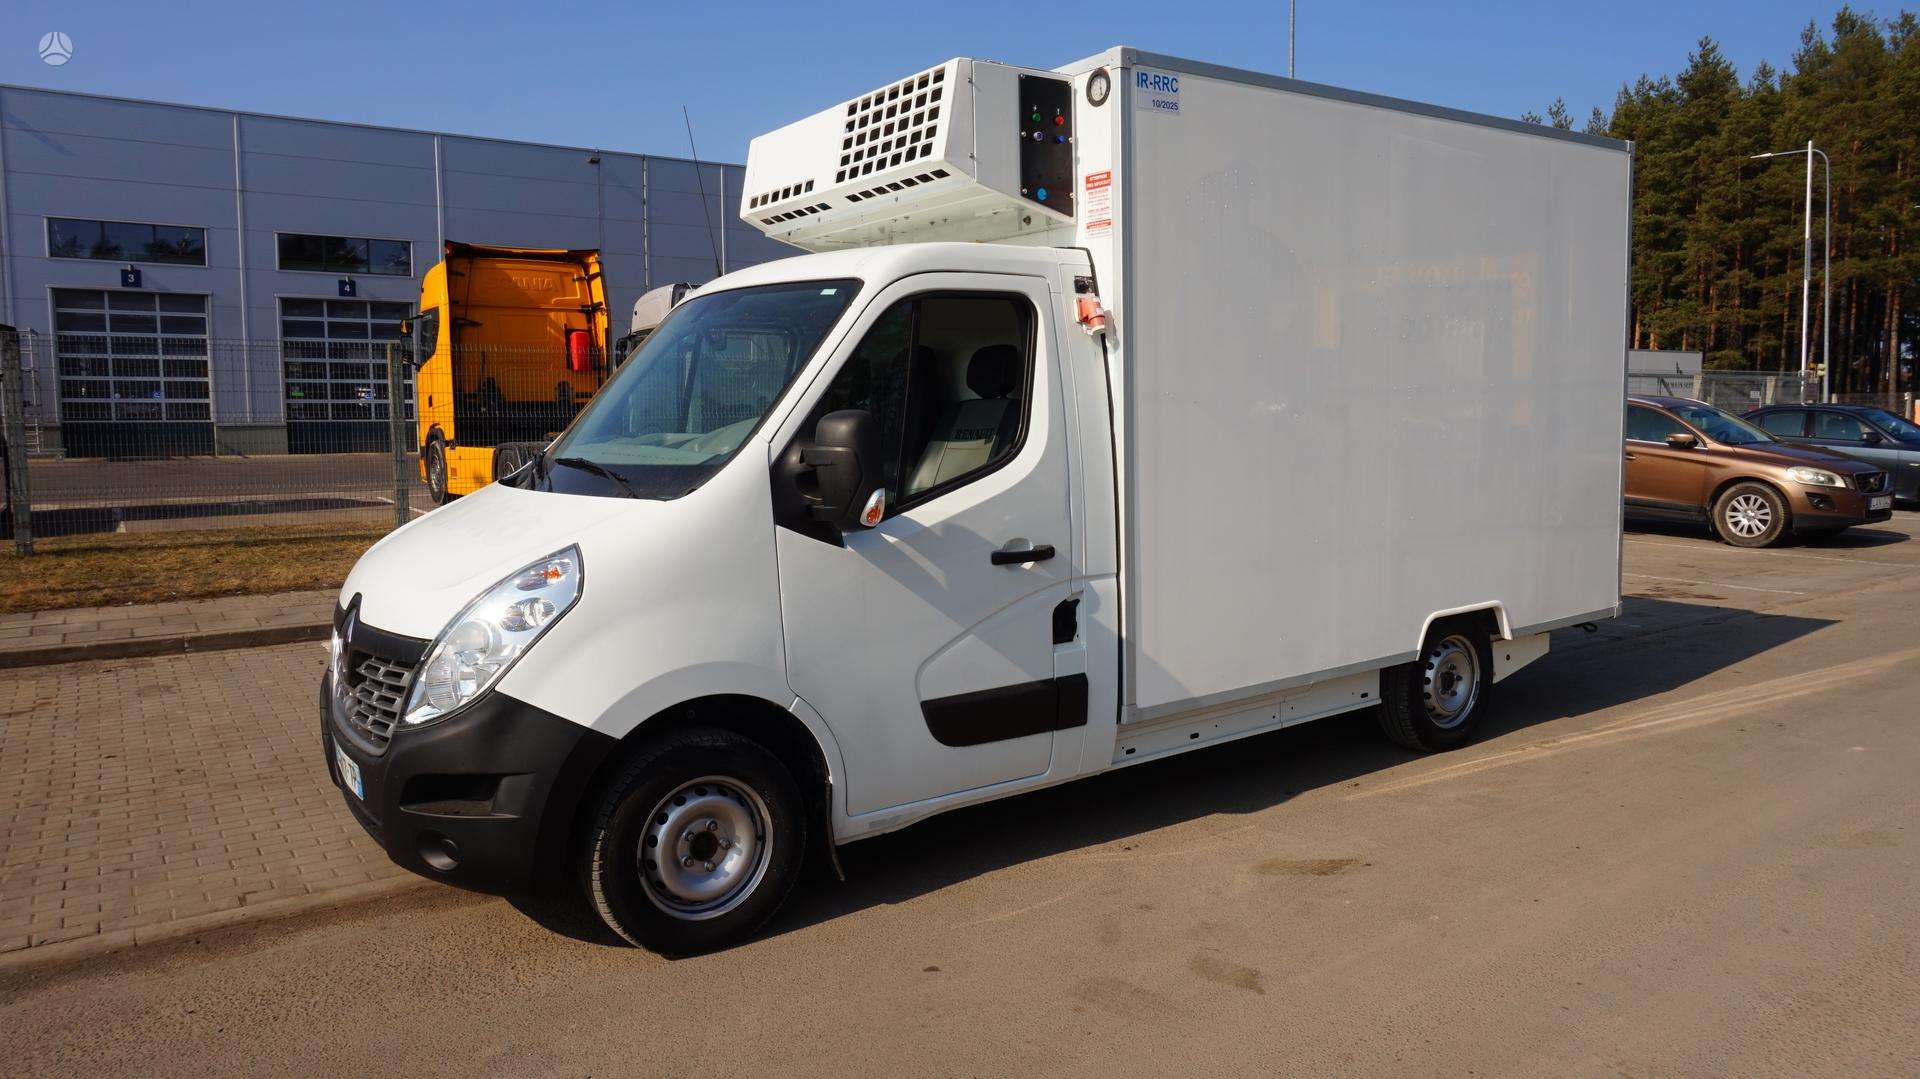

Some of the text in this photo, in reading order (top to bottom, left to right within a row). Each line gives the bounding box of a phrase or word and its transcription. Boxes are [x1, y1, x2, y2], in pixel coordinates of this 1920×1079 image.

[1136, 71, 1179, 93] IR-RRC
[1152, 99, 1179, 111] 10/2025
[128, 274, 135, 283] 3
[344, 284, 350, 292] 4
